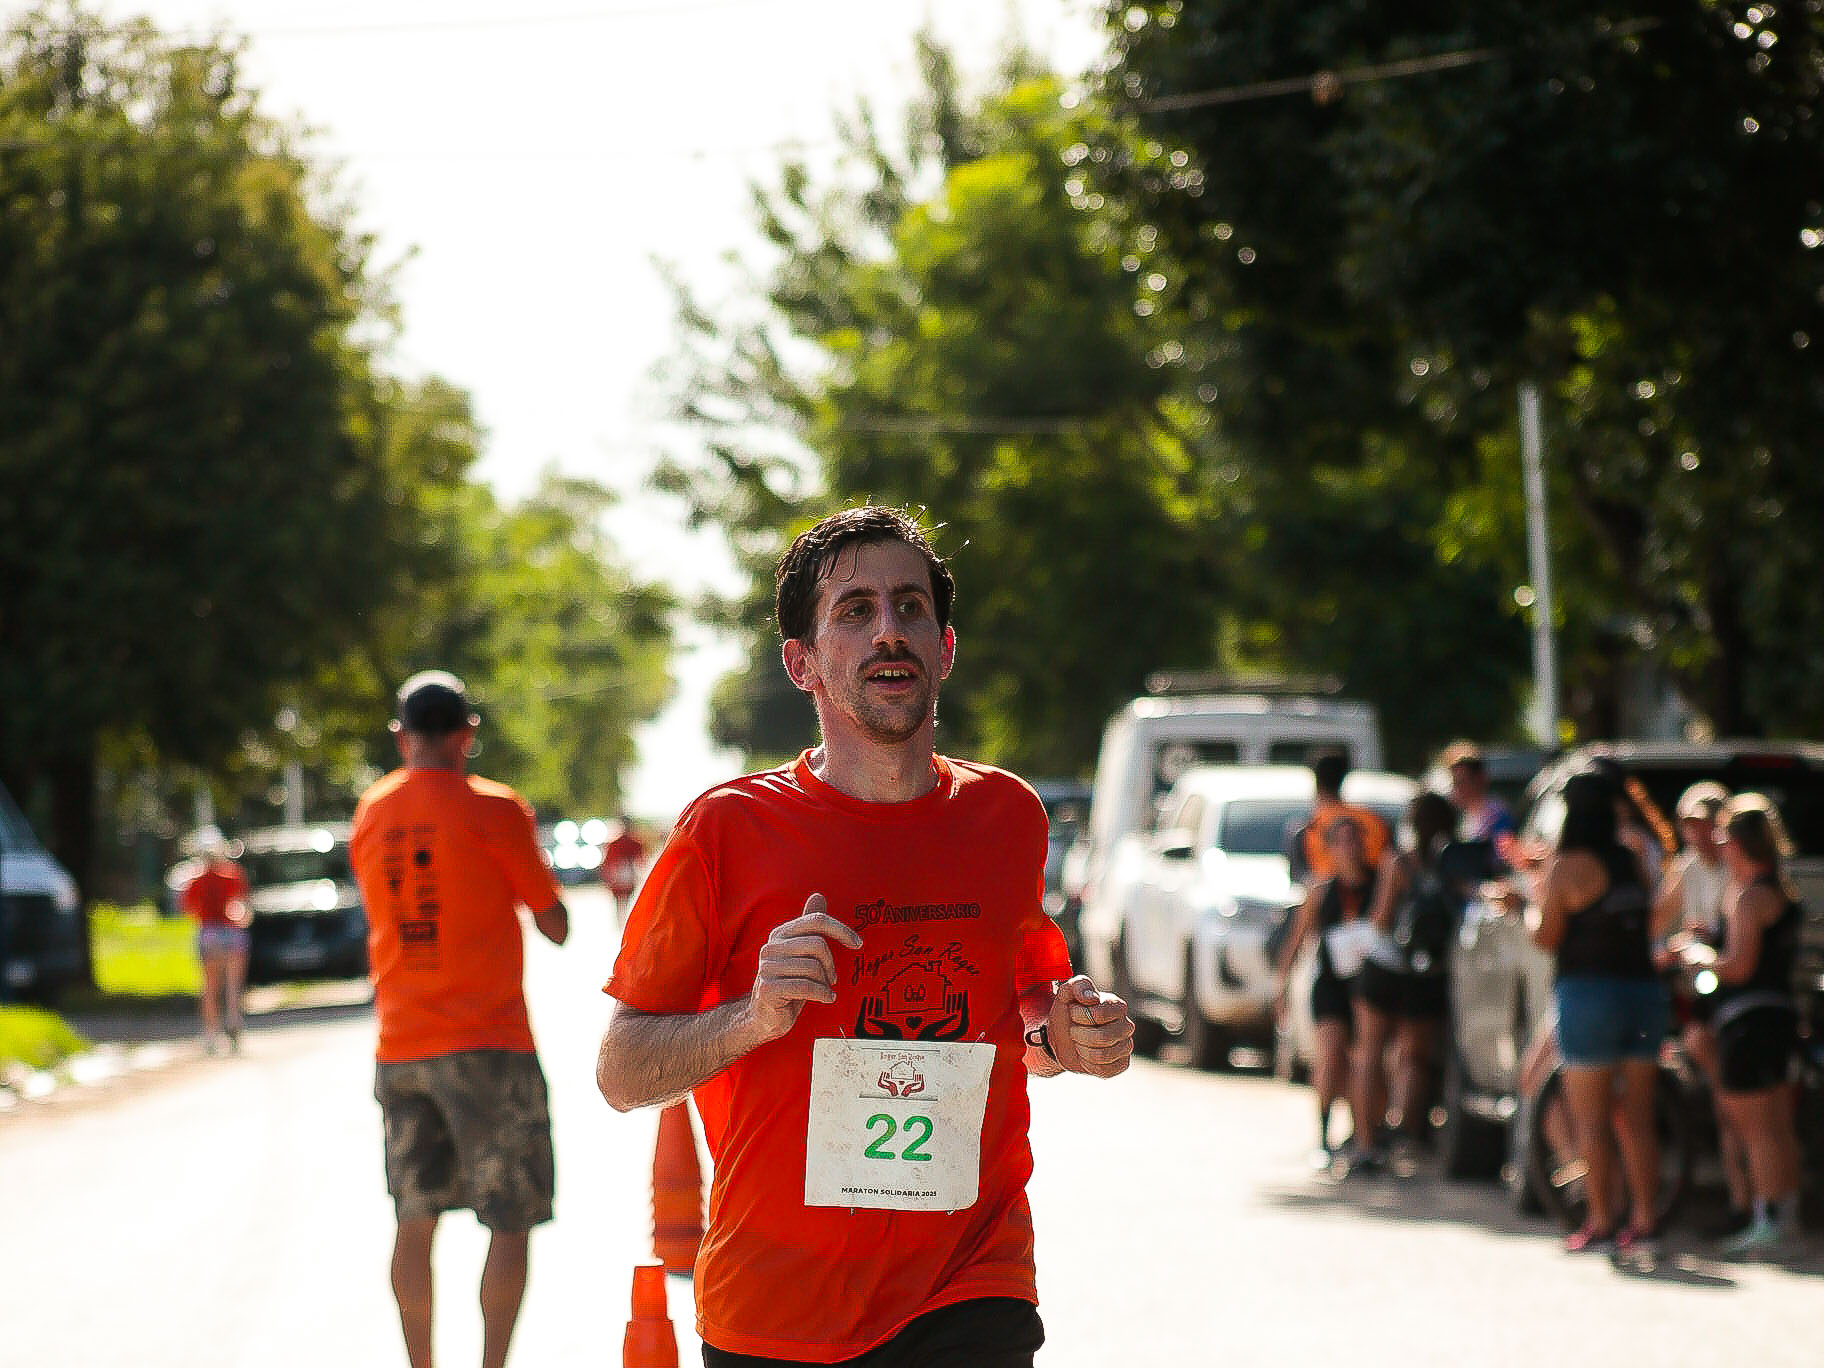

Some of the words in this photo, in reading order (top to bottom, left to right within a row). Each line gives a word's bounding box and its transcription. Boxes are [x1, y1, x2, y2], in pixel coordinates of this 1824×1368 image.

[899, 934, 934, 957] San
[864, 1113, 934, 1161] 22
[841, 1187, 879, 1195] MARATON
[880, 1189, 920, 1197] SOLIDARIA
